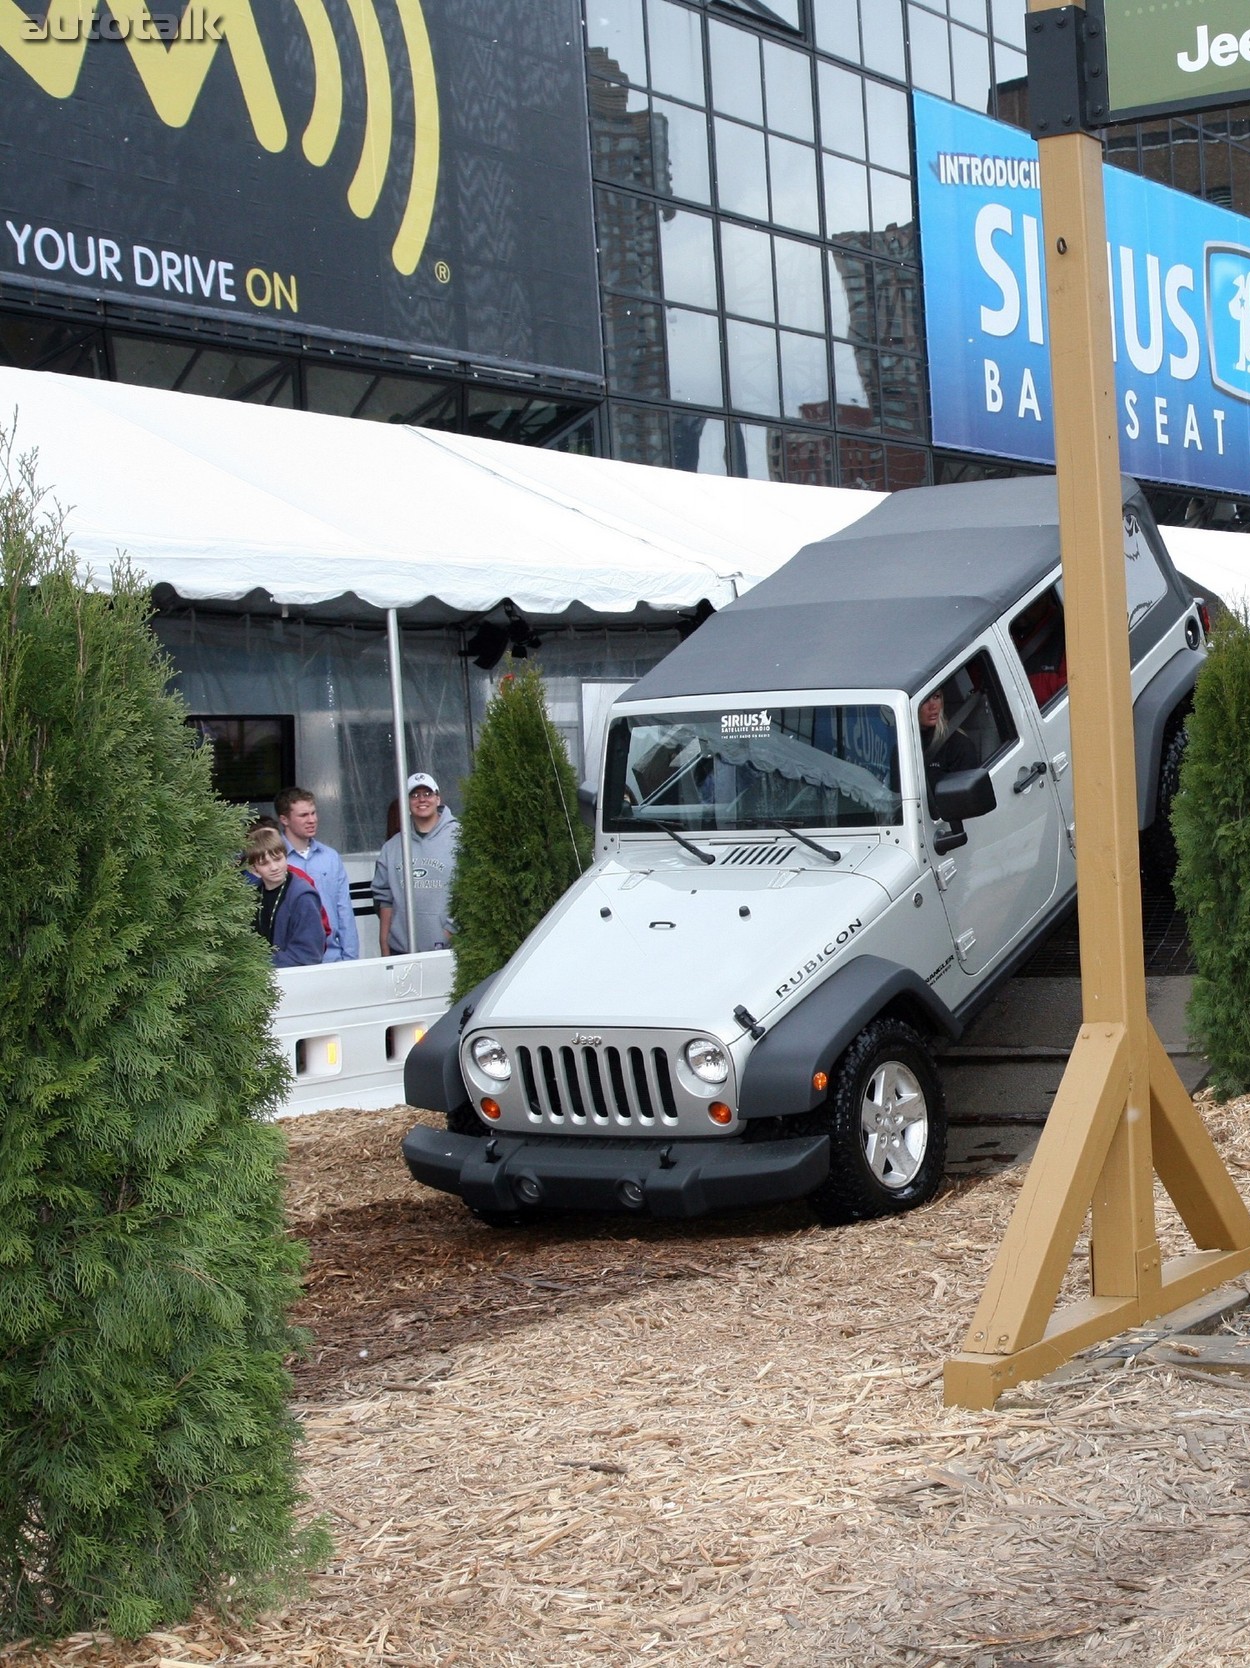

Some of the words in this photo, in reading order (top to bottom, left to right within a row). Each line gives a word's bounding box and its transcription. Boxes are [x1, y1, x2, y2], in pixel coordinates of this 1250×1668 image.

[5, 220, 123, 282] YOUR
[133, 245, 237, 302] DRIVE
[245, 268, 298, 313] ON
[975, 203, 1200, 381] SIUS
[984, 358, 1226, 456] BASEAT
[721, 713, 760, 728] SIRIUS
[775, 918, 863, 998] RUBICON
[571, 1032, 602, 1047] Jeep
